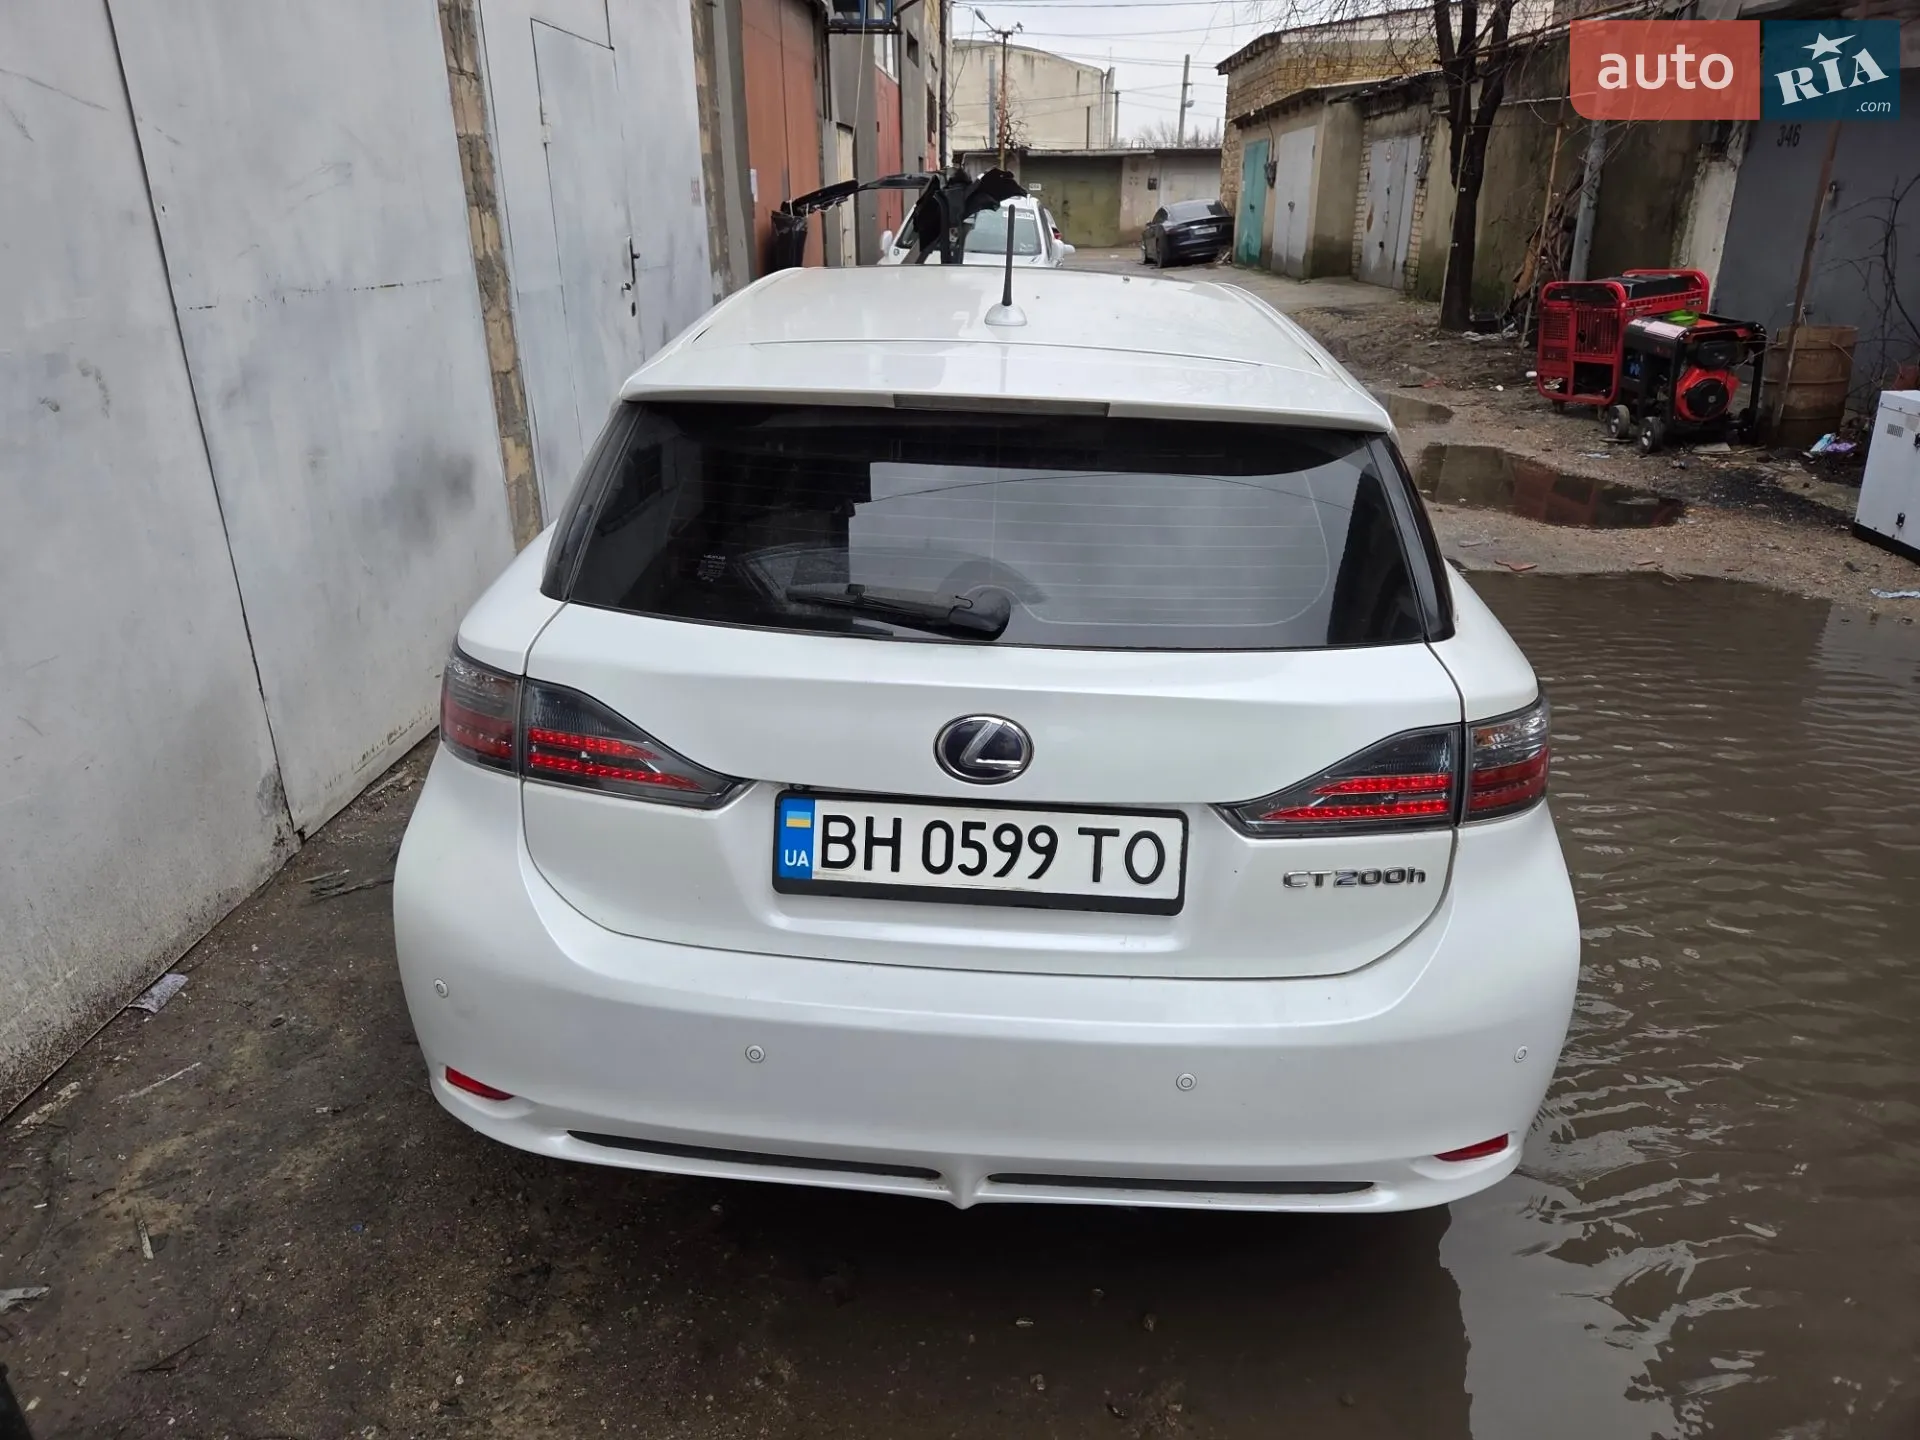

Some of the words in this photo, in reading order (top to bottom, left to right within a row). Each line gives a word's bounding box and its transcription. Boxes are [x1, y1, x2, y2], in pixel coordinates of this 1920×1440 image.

[1776, 124, 1802, 147] 346
[784, 849, 810, 867] UA
[821, 814, 901, 872] BH
[921, 820, 1058, 880] 0599
[1078, 827, 1165, 885] TO
